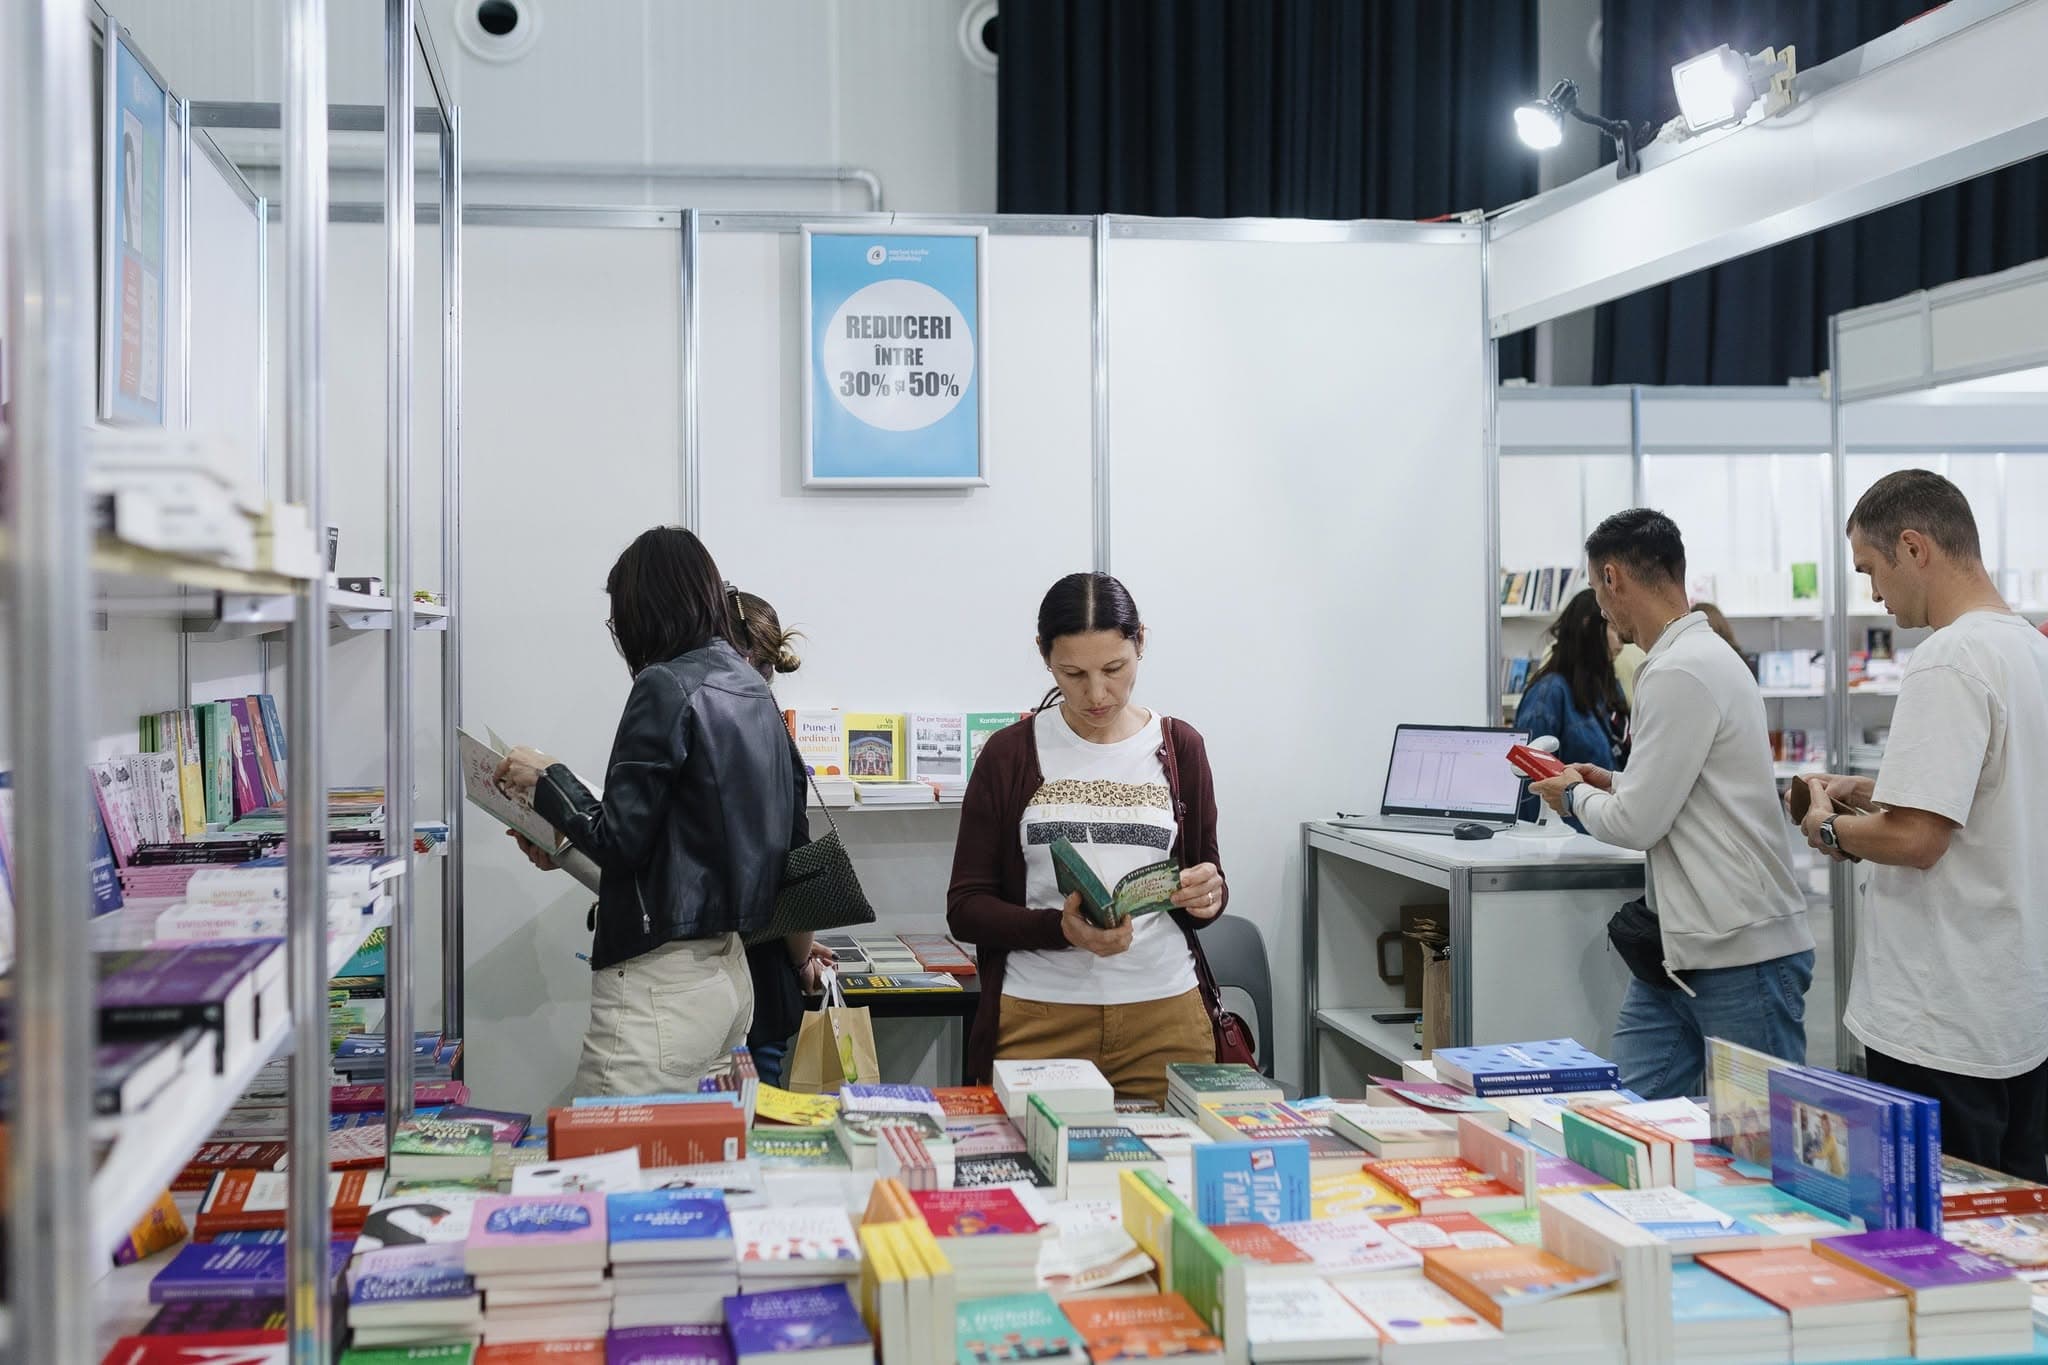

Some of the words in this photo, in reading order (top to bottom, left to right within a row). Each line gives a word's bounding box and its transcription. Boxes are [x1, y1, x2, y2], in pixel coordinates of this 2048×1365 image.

[846, 315, 951, 339] REDUCERI
[874, 344, 924, 366] ÎNTRE
[839, 371, 891, 397] 30%
[909, 371, 960, 397] 50%
[798, 734, 827, 743] ordine
